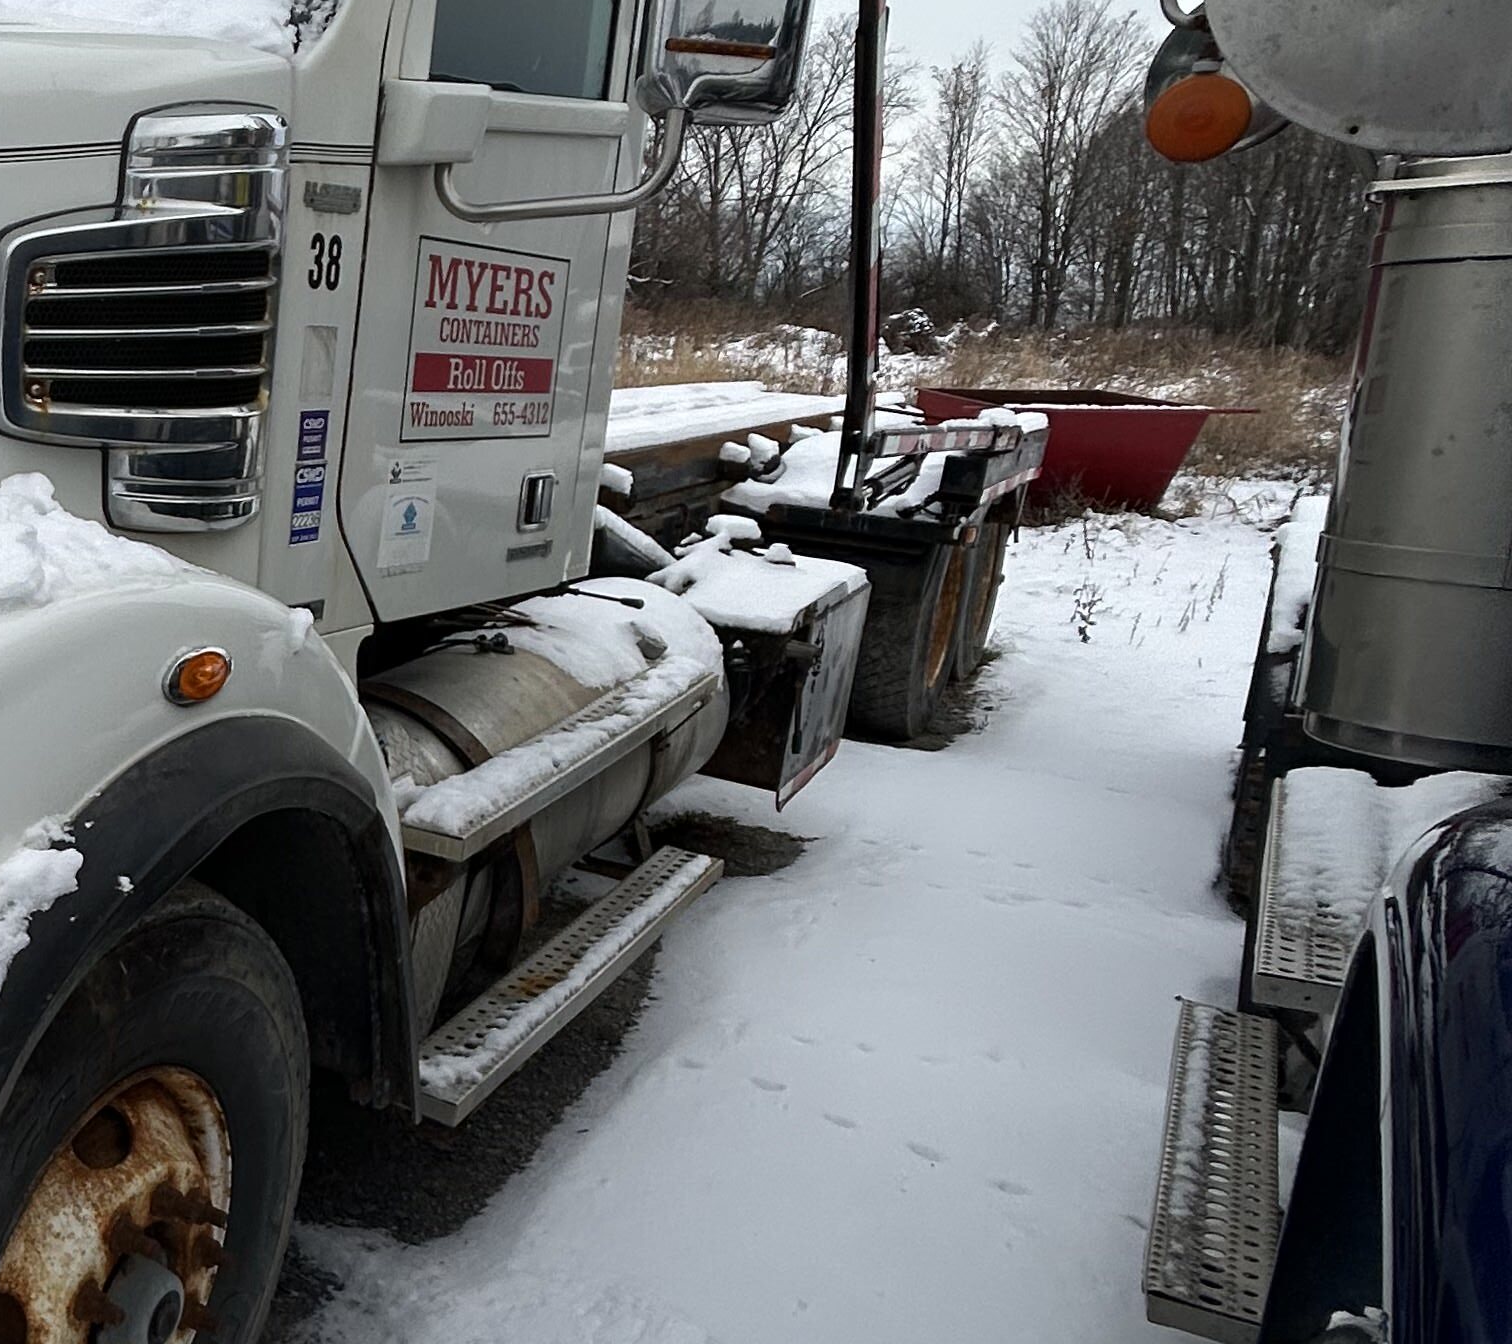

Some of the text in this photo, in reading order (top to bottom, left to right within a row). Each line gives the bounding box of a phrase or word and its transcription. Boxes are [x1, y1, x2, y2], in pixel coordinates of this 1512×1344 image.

[308, 232, 343, 291] 38
[424, 254, 555, 320] MYERS
[439, 316, 540, 348] CONTAINERS
[447, 357, 525, 390] Roll Offs
[410, 401, 550, 428] Winooski 655-4312
